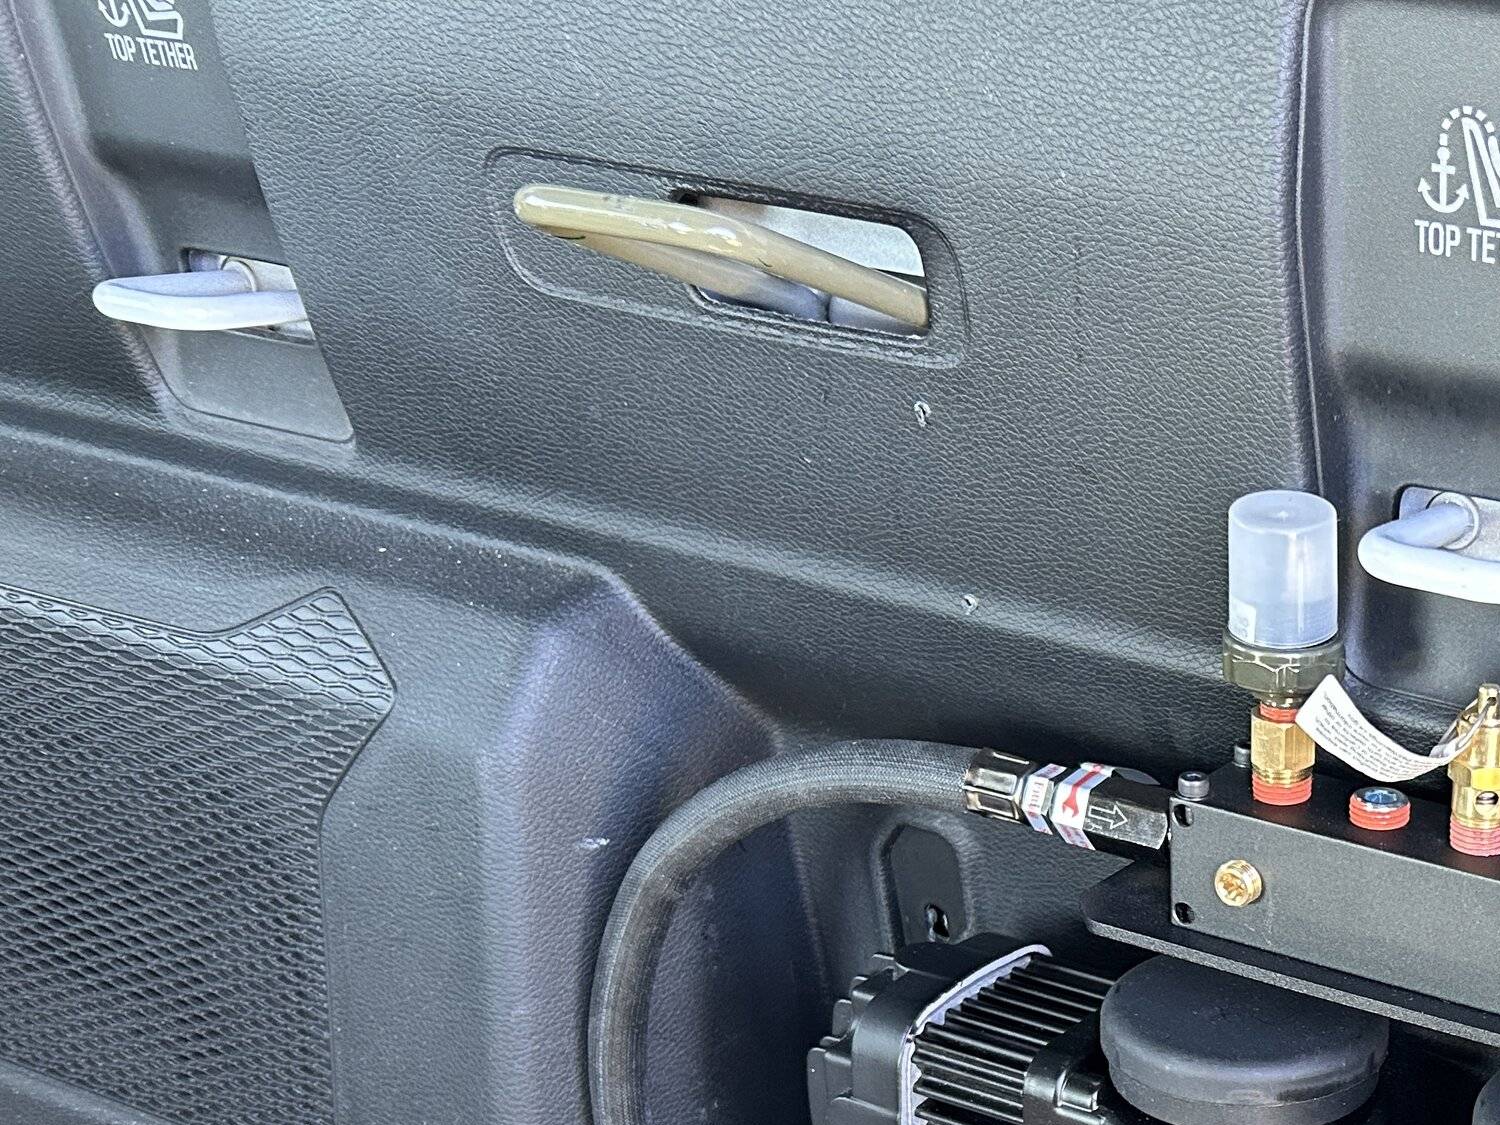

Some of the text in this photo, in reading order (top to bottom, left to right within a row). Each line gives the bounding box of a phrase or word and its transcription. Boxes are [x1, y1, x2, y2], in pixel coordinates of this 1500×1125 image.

[104, 32, 199, 71] TOP TETHER
[1415, 219, 1460, 257] TOP
